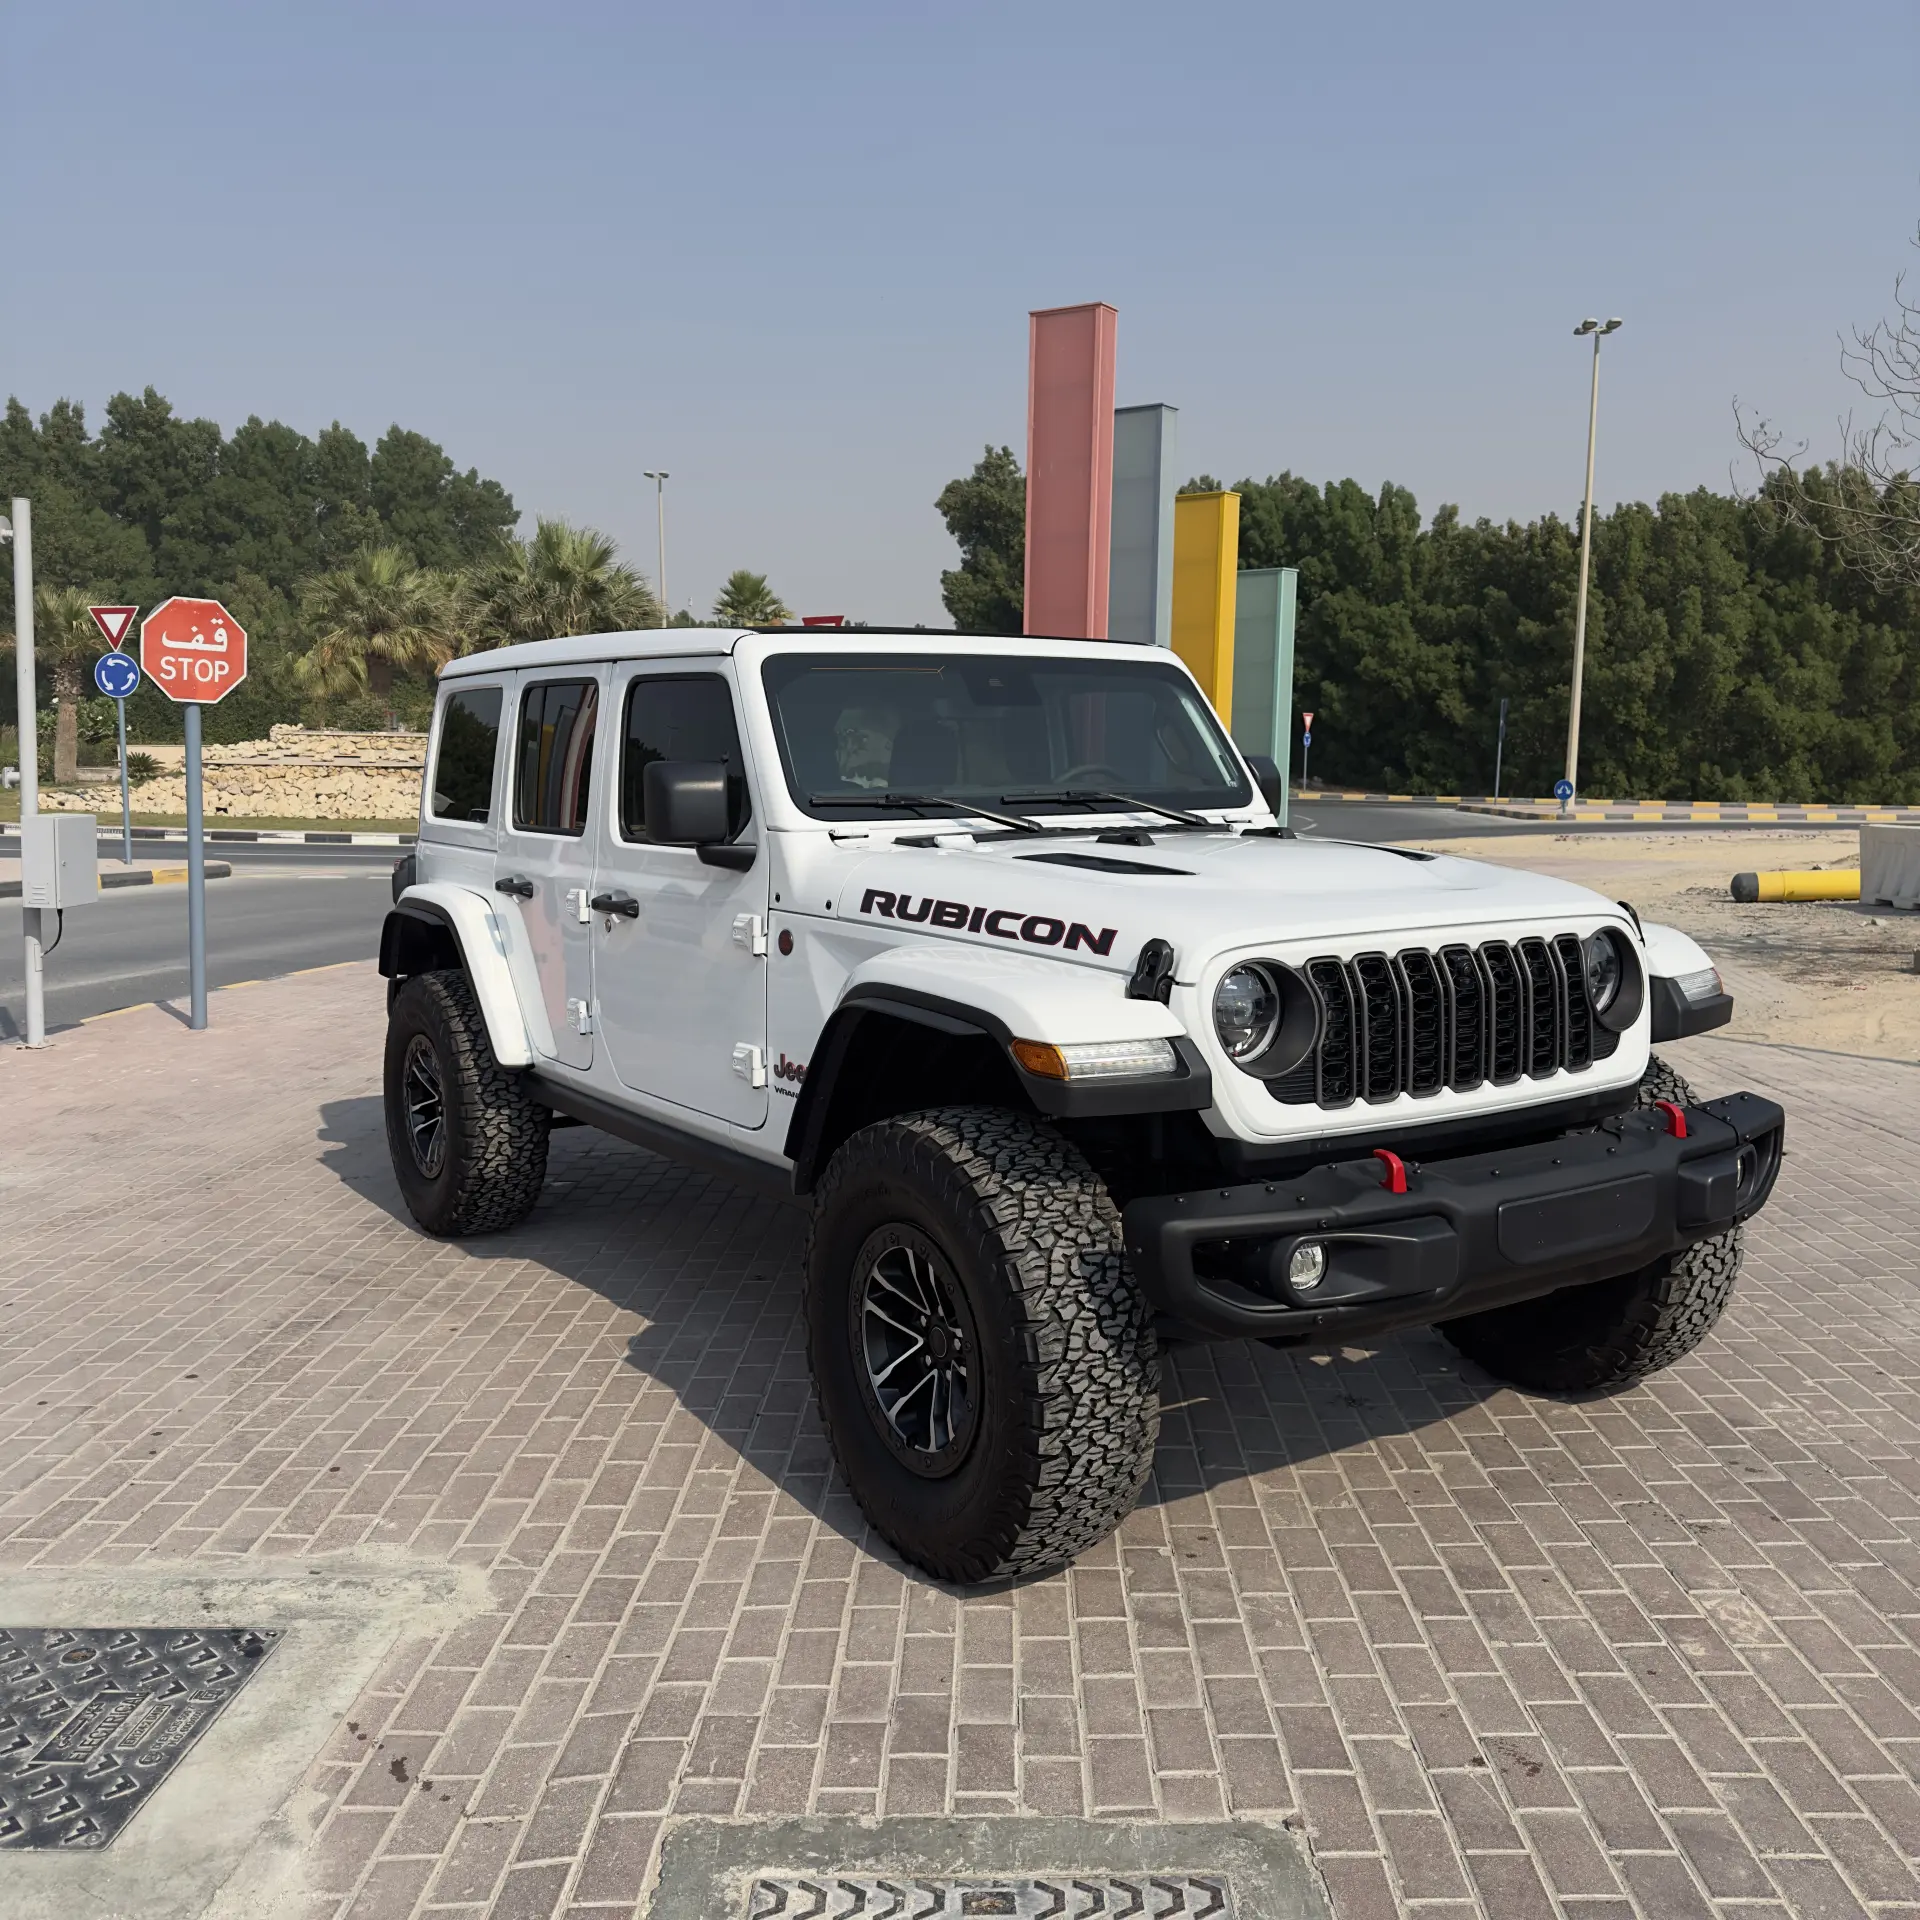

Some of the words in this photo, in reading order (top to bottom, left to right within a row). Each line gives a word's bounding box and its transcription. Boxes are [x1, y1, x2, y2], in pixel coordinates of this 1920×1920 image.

[161, 617, 228, 652] قف
[160, 656, 230, 683] STOP
[860, 888, 1118, 956] RUBICON
[773, 1053, 808, 1083] Jee
[69, 1692, 148, 1760] ELECTRICAL
